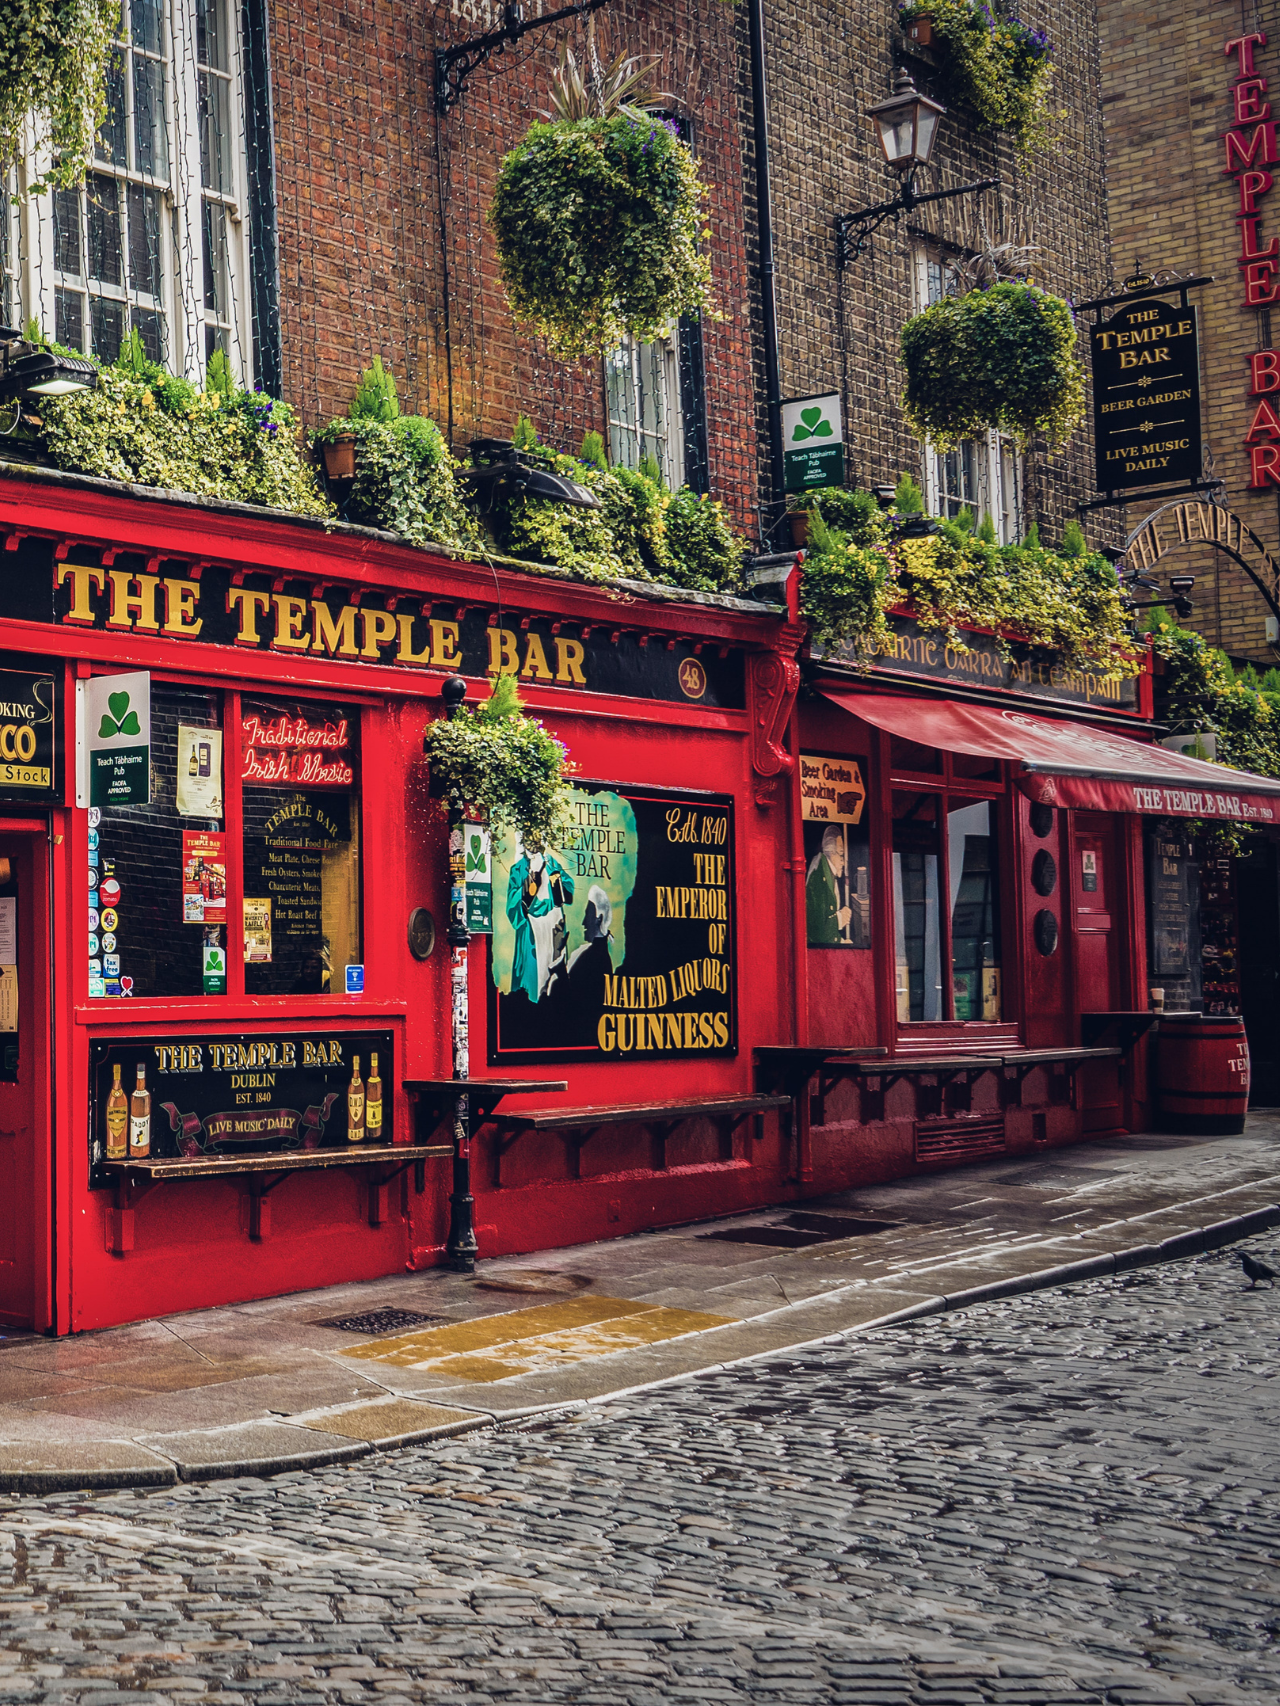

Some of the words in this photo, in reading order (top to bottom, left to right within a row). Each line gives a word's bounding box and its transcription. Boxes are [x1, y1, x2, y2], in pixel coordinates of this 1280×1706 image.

[1220, 32, 1280, 308] TEMPLE
[1126, 309, 1160, 325] THE
[1096, 320, 1193, 351] TEMPLE
[1119, 347, 1171, 370] BAR
[1101, 399, 1135, 413] BEER
[1136, 389, 1192, 407] GARDEN
[1246, 349, 1280, 490] BAR
[1106, 446, 1139, 460] LIVE
[1142, 438, 1190, 455] MUSIC
[1125, 456, 1170, 472] DAILY
[1126, 515, 1169, 571] THE
[1173, 501, 1251, 559] TEMPLE
[57, 562, 203, 638] THE
[227, 588, 463, 672] TEMPLE
[487, 627, 587, 687] BAR
[682, 666, 704, 692] 48
[243, 718, 347, 746] Traditional
[97, 757, 113, 766] Teach
[114, 766, 125, 775] Pub
[241, 749, 288, 779] Irish
[297, 753, 352, 783] Music
[801, 760, 820, 779] Beer
[822, 763, 852, 783] Garden
[5, 766, 49, 784] Stock
[296, 794, 306, 802] The
[802, 780, 836, 803] Smoking
[1133, 787, 1163, 810] THE
[1163, 789, 1216, 814] TEMPLE
[1216, 794, 1242, 816] BAR
[264, 804, 313, 833] TEMPLE
[316, 810, 338, 837] BAR
[575, 801, 610, 827] THE
[809, 800, 829, 819] Area
[264, 835, 302, 847] Traditional
[305, 838, 321, 848] Food
[324, 840, 338, 849] Fare
[701, 817, 727, 845] 1840
[269, 853, 282, 862] Meat
[301, 855, 320, 864] Cheese
[576, 854, 611, 880] BAR
[694, 853, 726, 885] THE
[1163, 857, 1179, 875] BAR
[261, 867, 277, 876] Fresh
[277, 895, 298, 905] Toasted
[655, 886, 727, 921] EMPEROR
[275, 910, 286, 919] Hot
[288, 910, 303, 919] Roast
[305, 911, 317, 920] Beef
[708, 923, 727, 954] OF
[106, 958, 116, 966] tax
[603, 974, 667, 1009] MALTED
[668, 958, 730, 1002] LIQUORS
[597, 1012, 729, 1052] GUINNESS
[155, 1045, 203, 1073] THE
[209, 1042, 296, 1071] TEMPLE
[302, 1040, 345, 1068] BAR
[231, 1073, 276, 1089] DUBLIN
[235, 1093, 253, 1104] EST.
[255, 1092, 271, 1103] 1840
[209, 1121, 233, 1135] LIVE
[235, 1118, 264, 1132] MUSIC
[267, 1117, 296, 1131] DAILY
